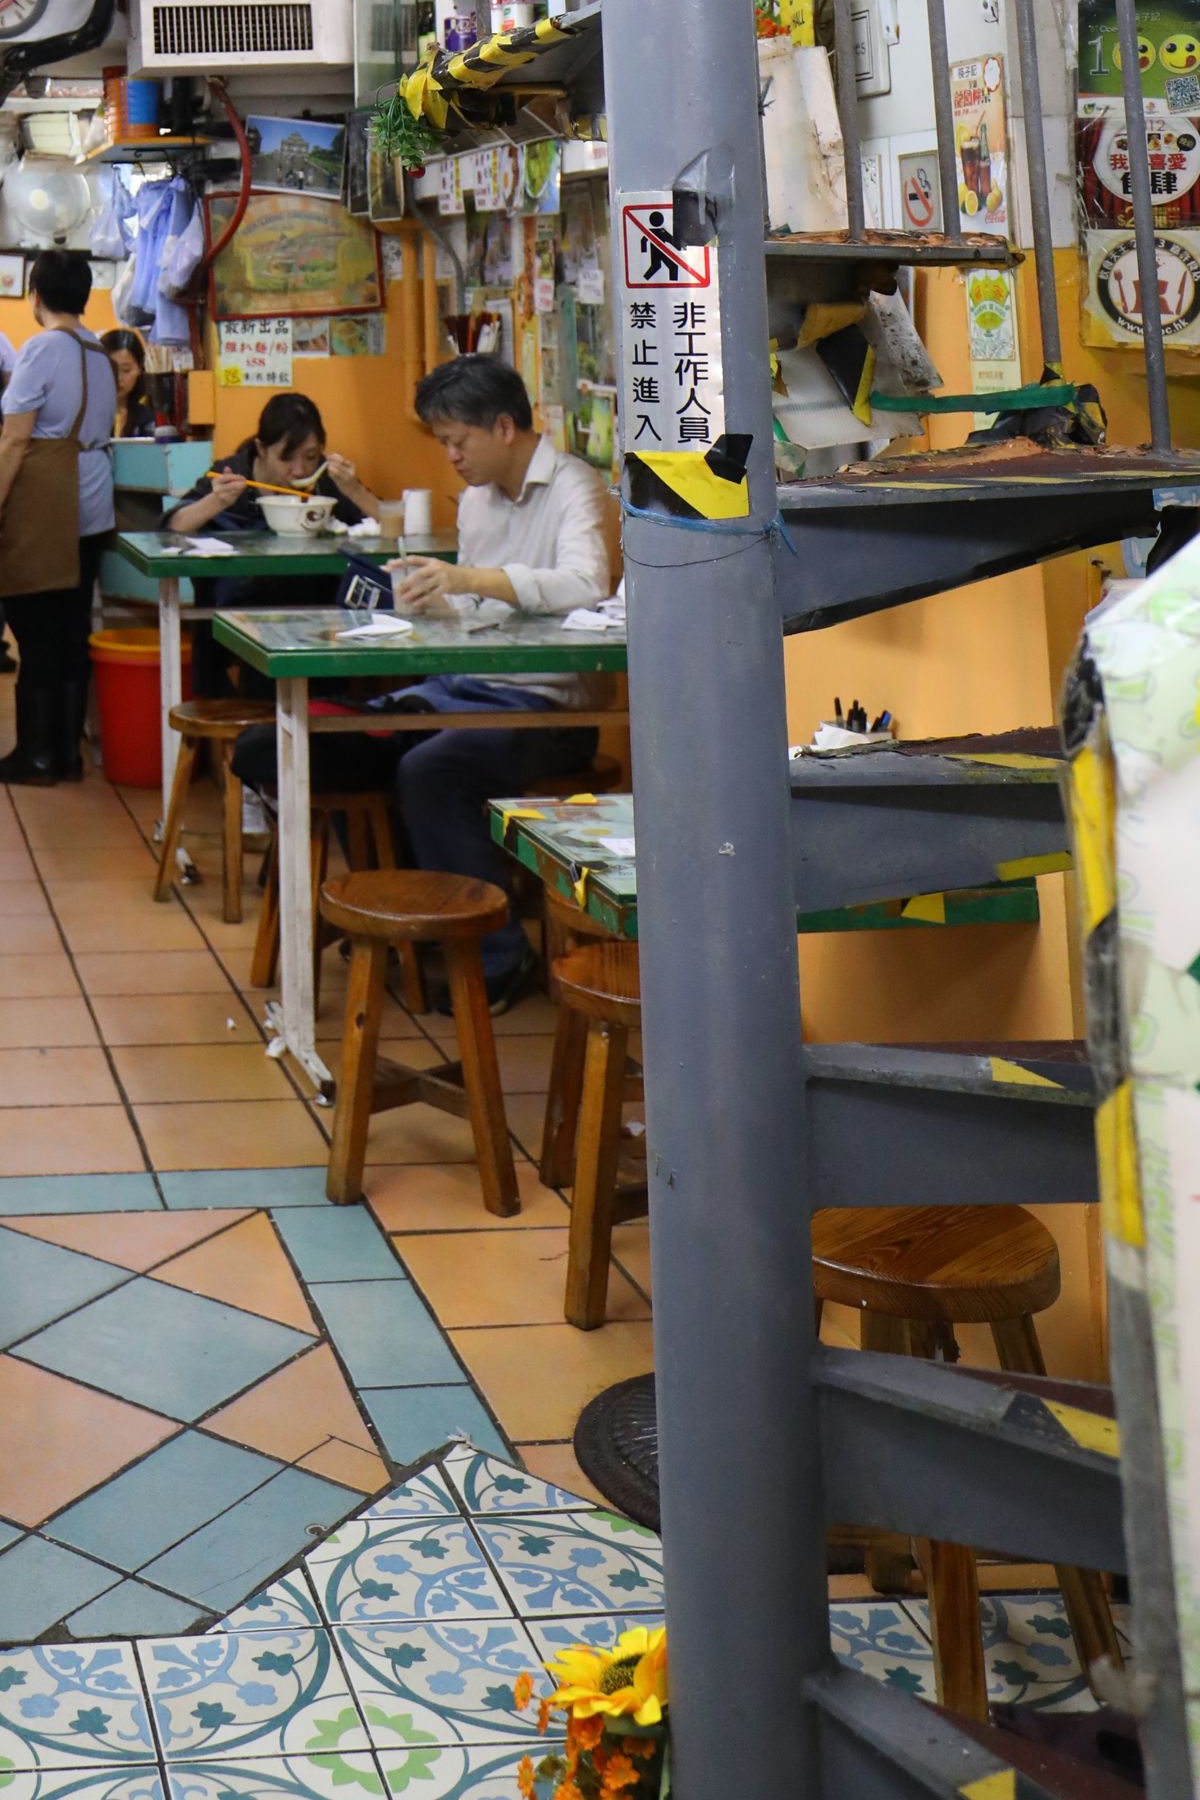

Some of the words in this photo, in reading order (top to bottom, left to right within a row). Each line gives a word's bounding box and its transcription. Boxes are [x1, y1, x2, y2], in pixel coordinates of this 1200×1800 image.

[1110, 153, 1187, 170] 我喜愛
[630, 302, 662, 441] 禁止進入
[673, 302, 712, 443] 非工作人員
